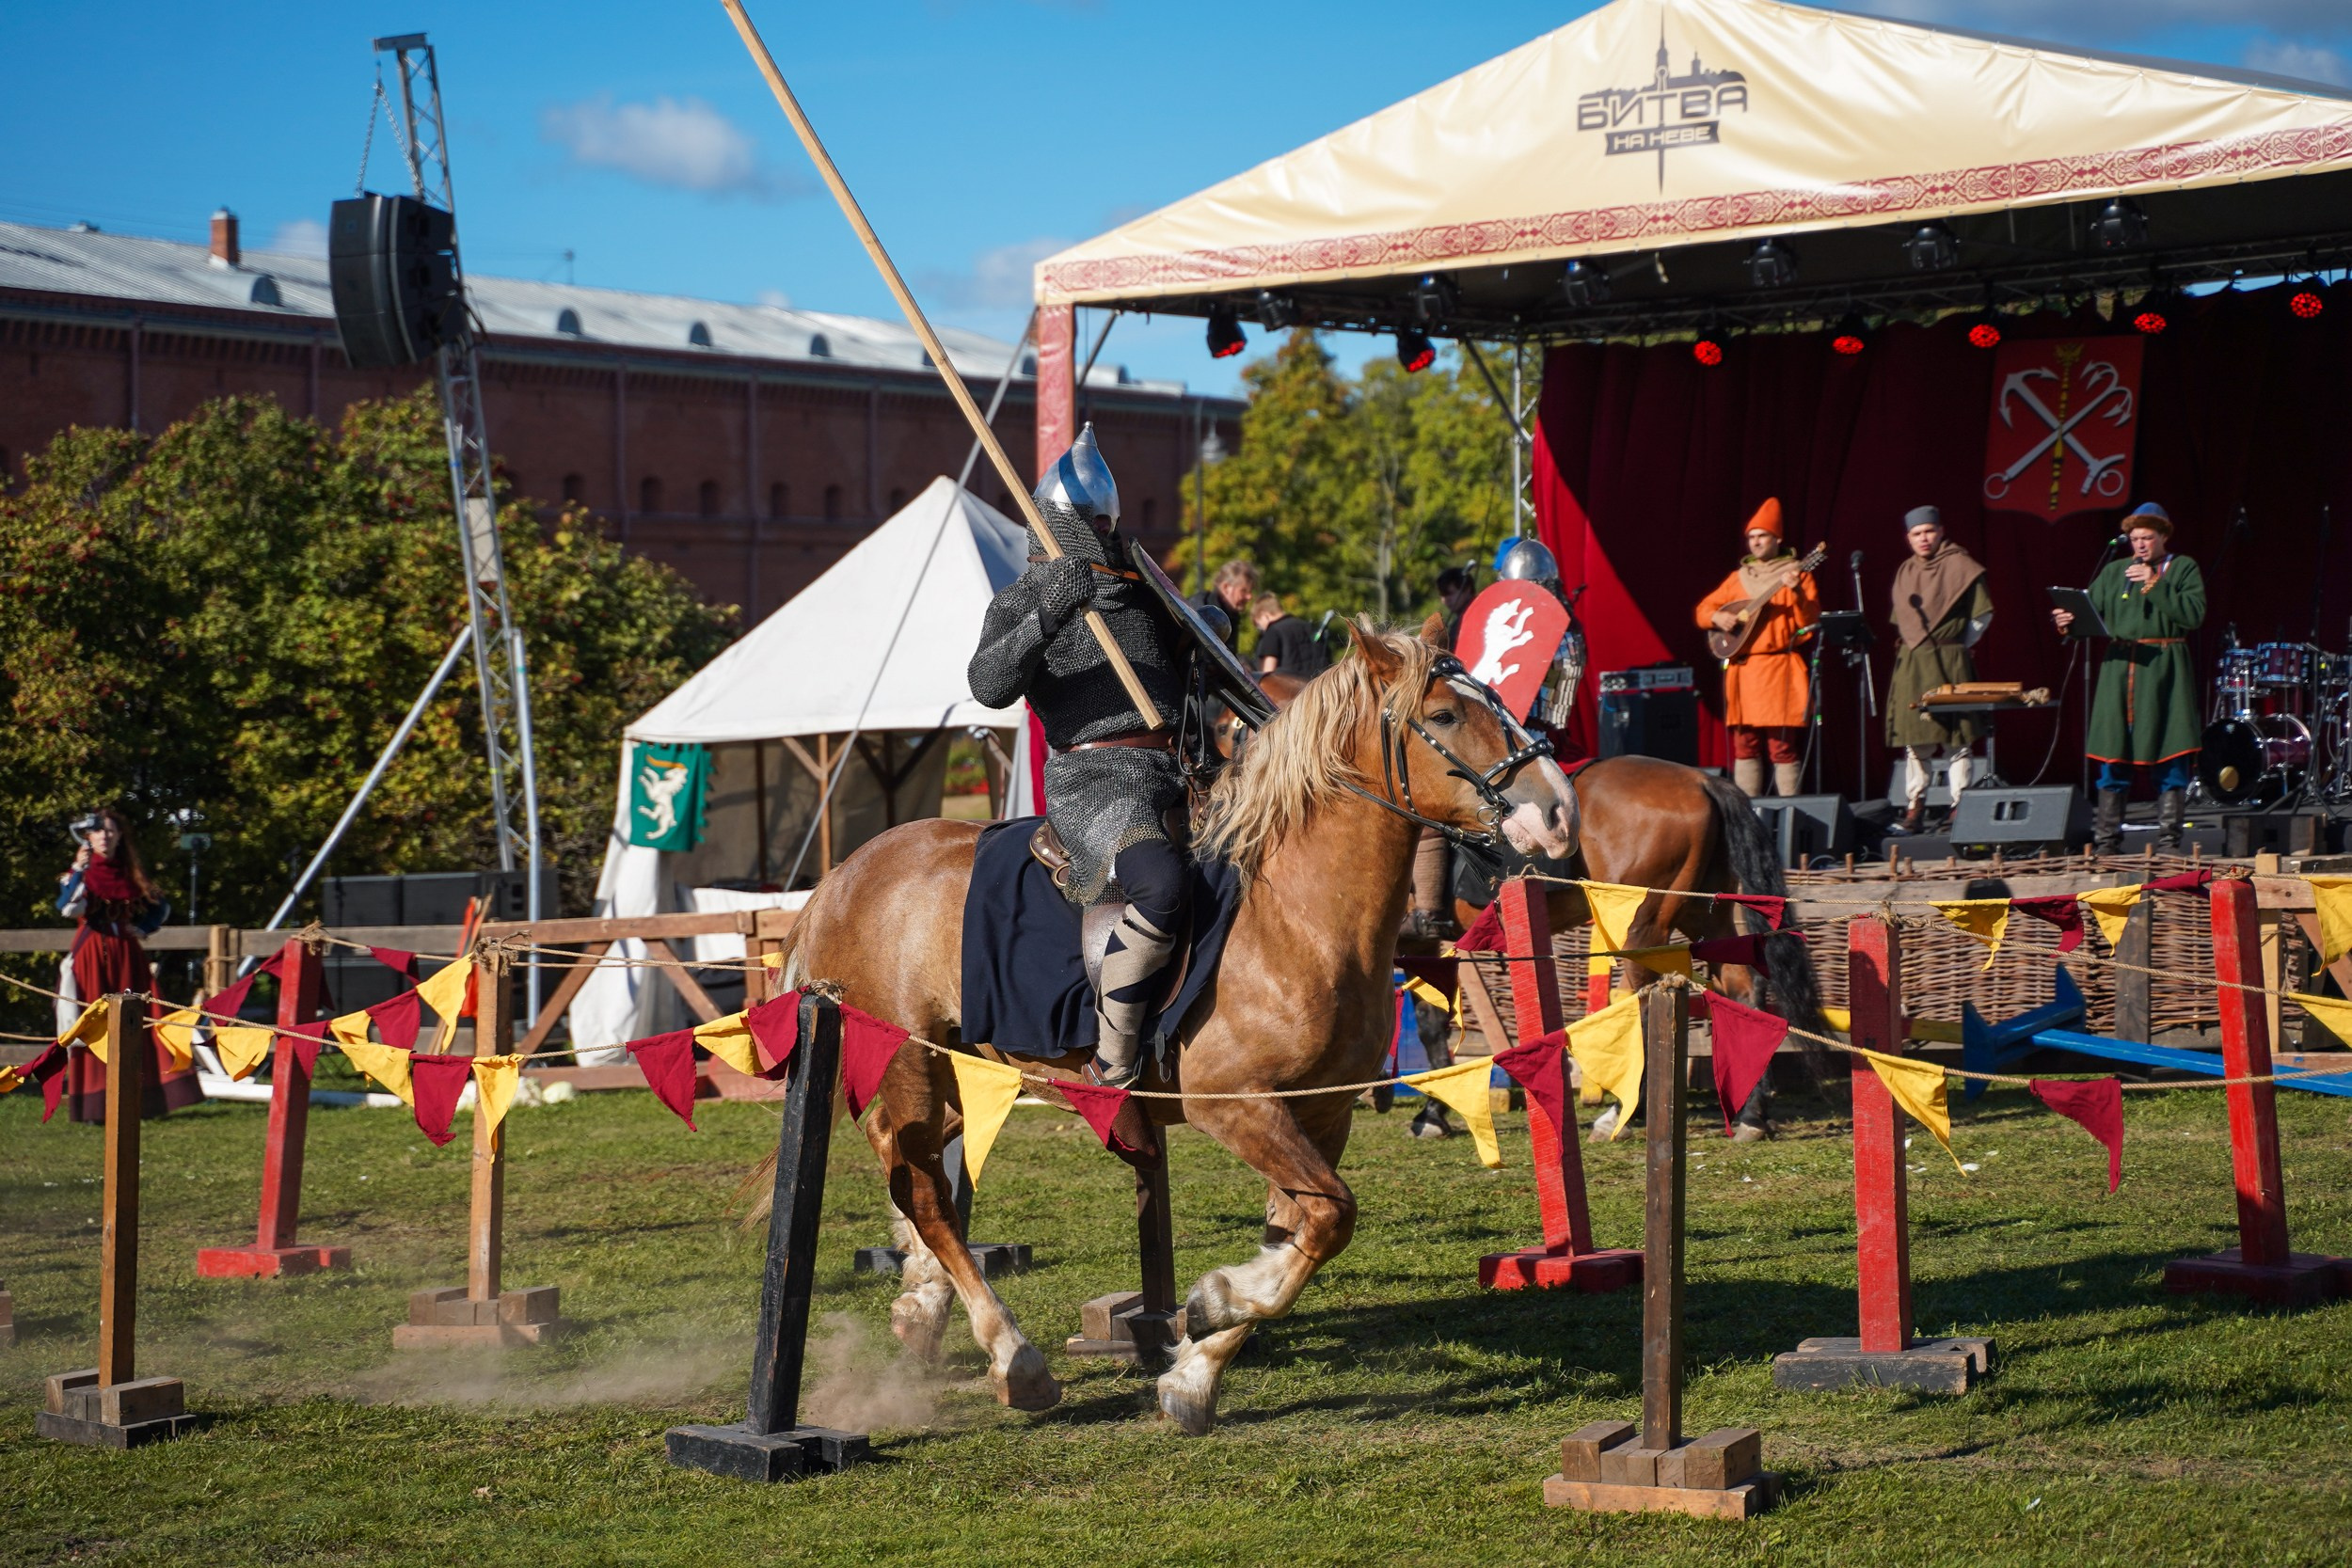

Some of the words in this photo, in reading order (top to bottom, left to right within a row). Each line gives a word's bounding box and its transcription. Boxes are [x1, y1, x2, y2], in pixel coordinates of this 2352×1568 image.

[1578, 85, 1748, 132] БИТВА
[1613, 133, 1645, 151] НА
[1648, 126, 1712, 147] НЕВЕ
